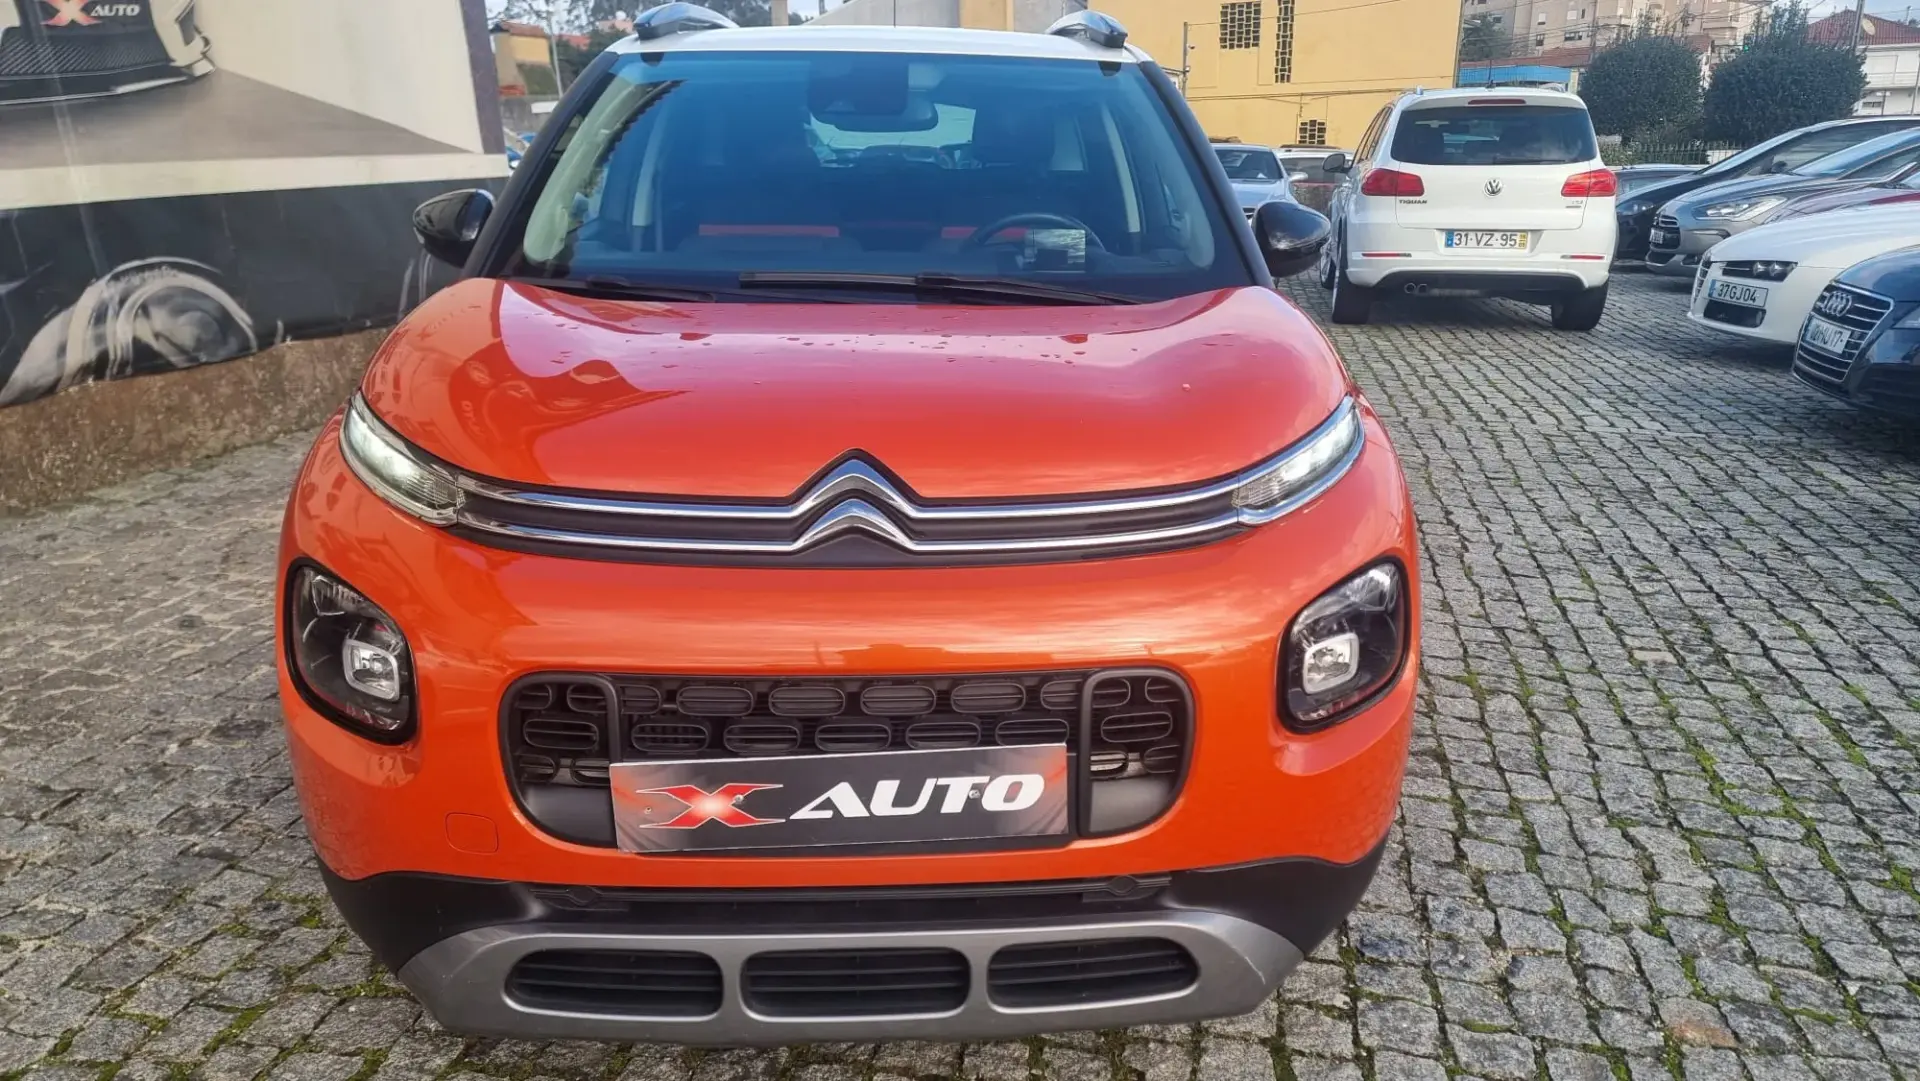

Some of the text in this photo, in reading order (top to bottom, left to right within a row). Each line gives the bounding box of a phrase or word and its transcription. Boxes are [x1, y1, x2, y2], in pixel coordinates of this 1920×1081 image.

[90, 4, 140, 17] AUTO
[636, 774, 1045, 829] X AUTO
